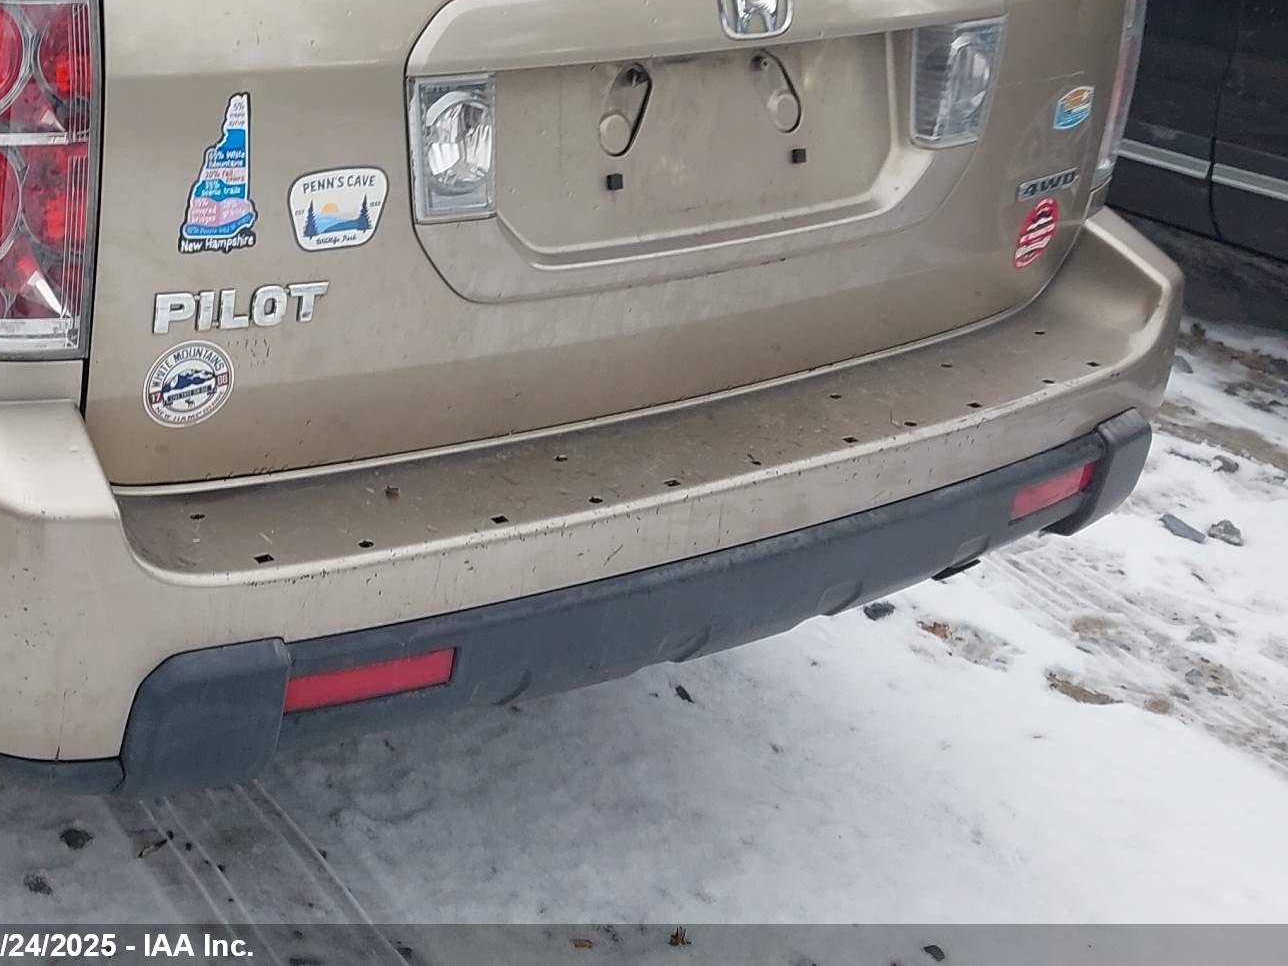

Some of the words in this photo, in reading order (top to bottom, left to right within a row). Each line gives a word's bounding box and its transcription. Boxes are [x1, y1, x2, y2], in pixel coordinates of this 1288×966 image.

[302, 176, 344, 194] PENN'S
[347, 175, 376, 188] CAVE
[1022, 171, 1076, 195] 4WD
[181, 239, 203, 253] New
[205, 233, 254, 252] Hampshire
[152, 281, 329, 334] PILOT
[153, 359, 173, 387] WHITE
[173, 347, 225, 372] MOUNTAINS
